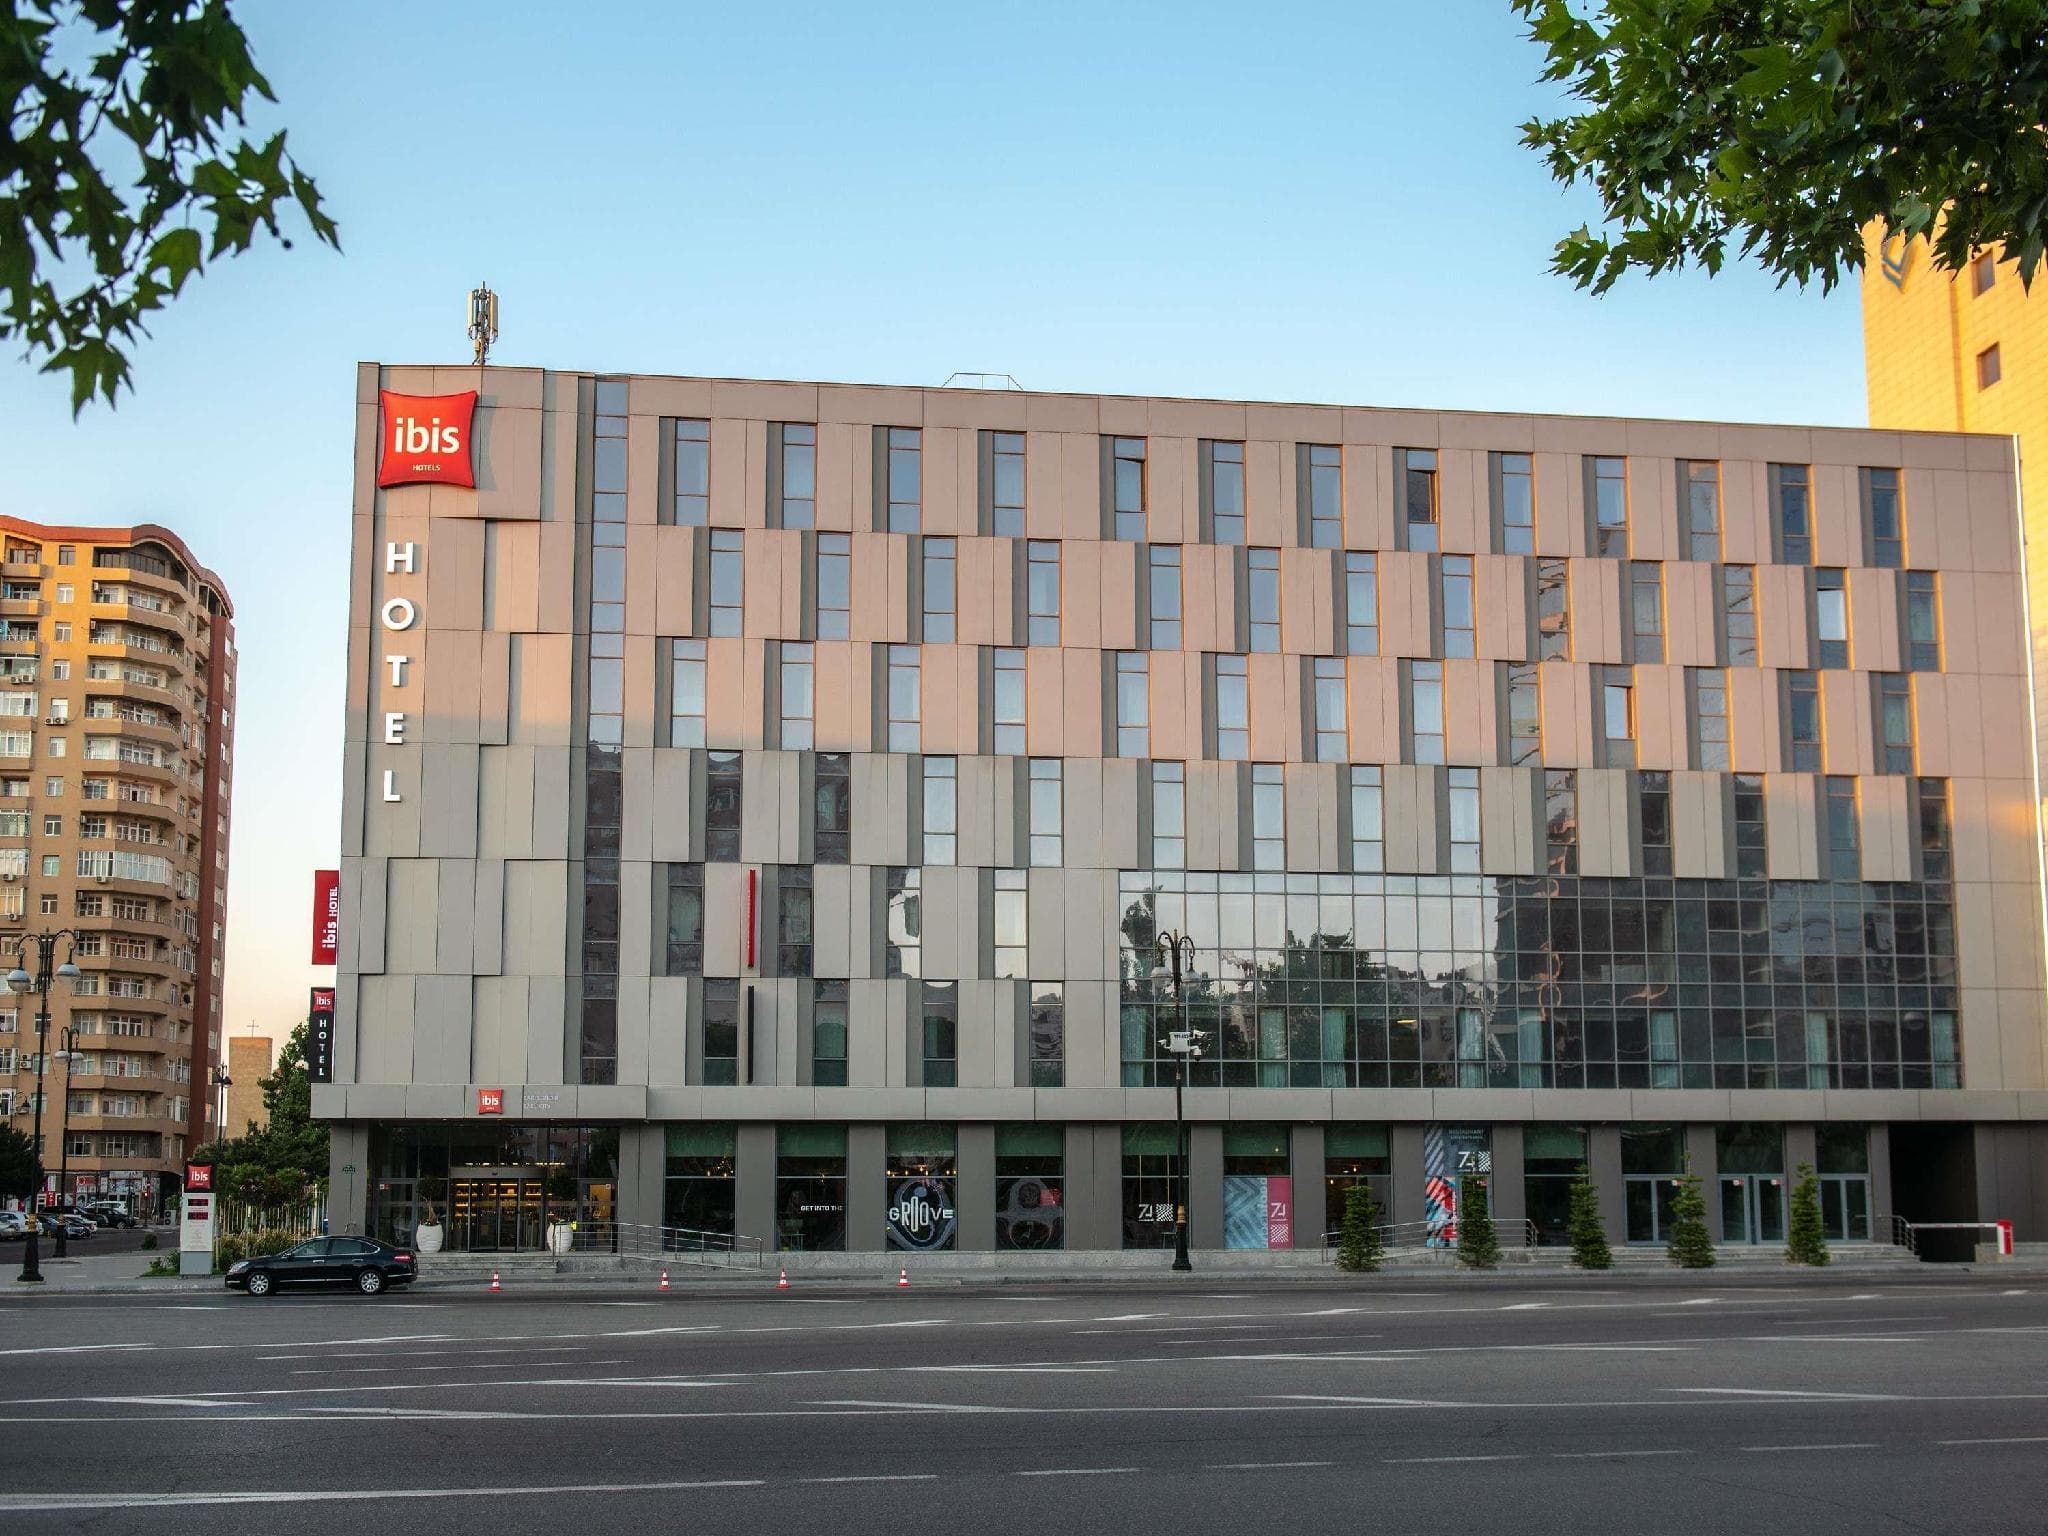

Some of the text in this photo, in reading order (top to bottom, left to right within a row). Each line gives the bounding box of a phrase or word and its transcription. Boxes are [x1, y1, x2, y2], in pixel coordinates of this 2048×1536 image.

[395, 417, 460, 454] ibis
[382, 542, 415, 802] HOTEL
[322, 886, 338, 948] ibis HOTEL
[316, 997, 331, 1006] ibis
[318, 1019, 327, 1076] HOTEL
[482, 1095, 499, 1105] ibis
[191, 1171, 209, 1181] ibis
[889, 1196, 954, 1232] GROOVE
